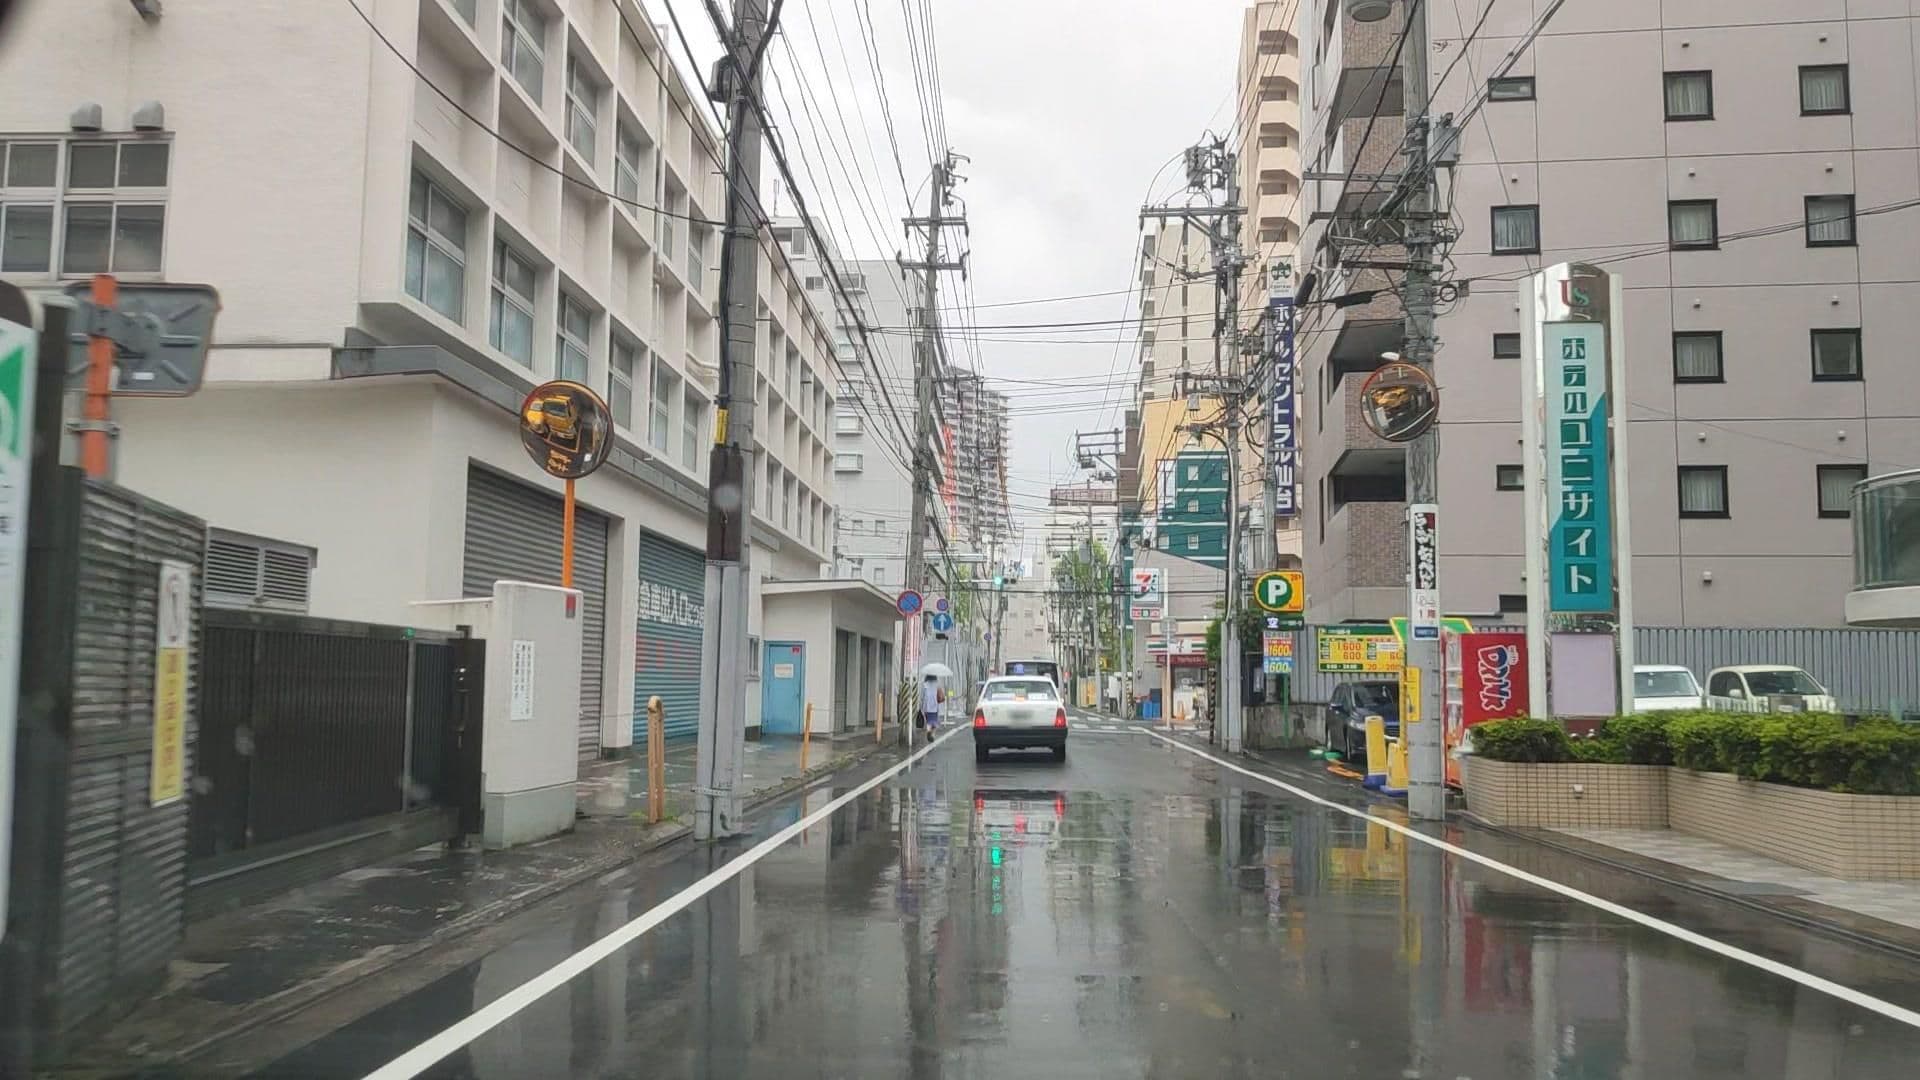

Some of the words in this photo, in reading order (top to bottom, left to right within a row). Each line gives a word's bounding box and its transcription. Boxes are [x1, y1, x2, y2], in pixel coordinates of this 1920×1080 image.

[1273, 303, 1293, 509] ホテルセントラル仙台
[1562, 338, 1594, 594] ホテルユニサイト
[1268, 579, 1288, 604] P
